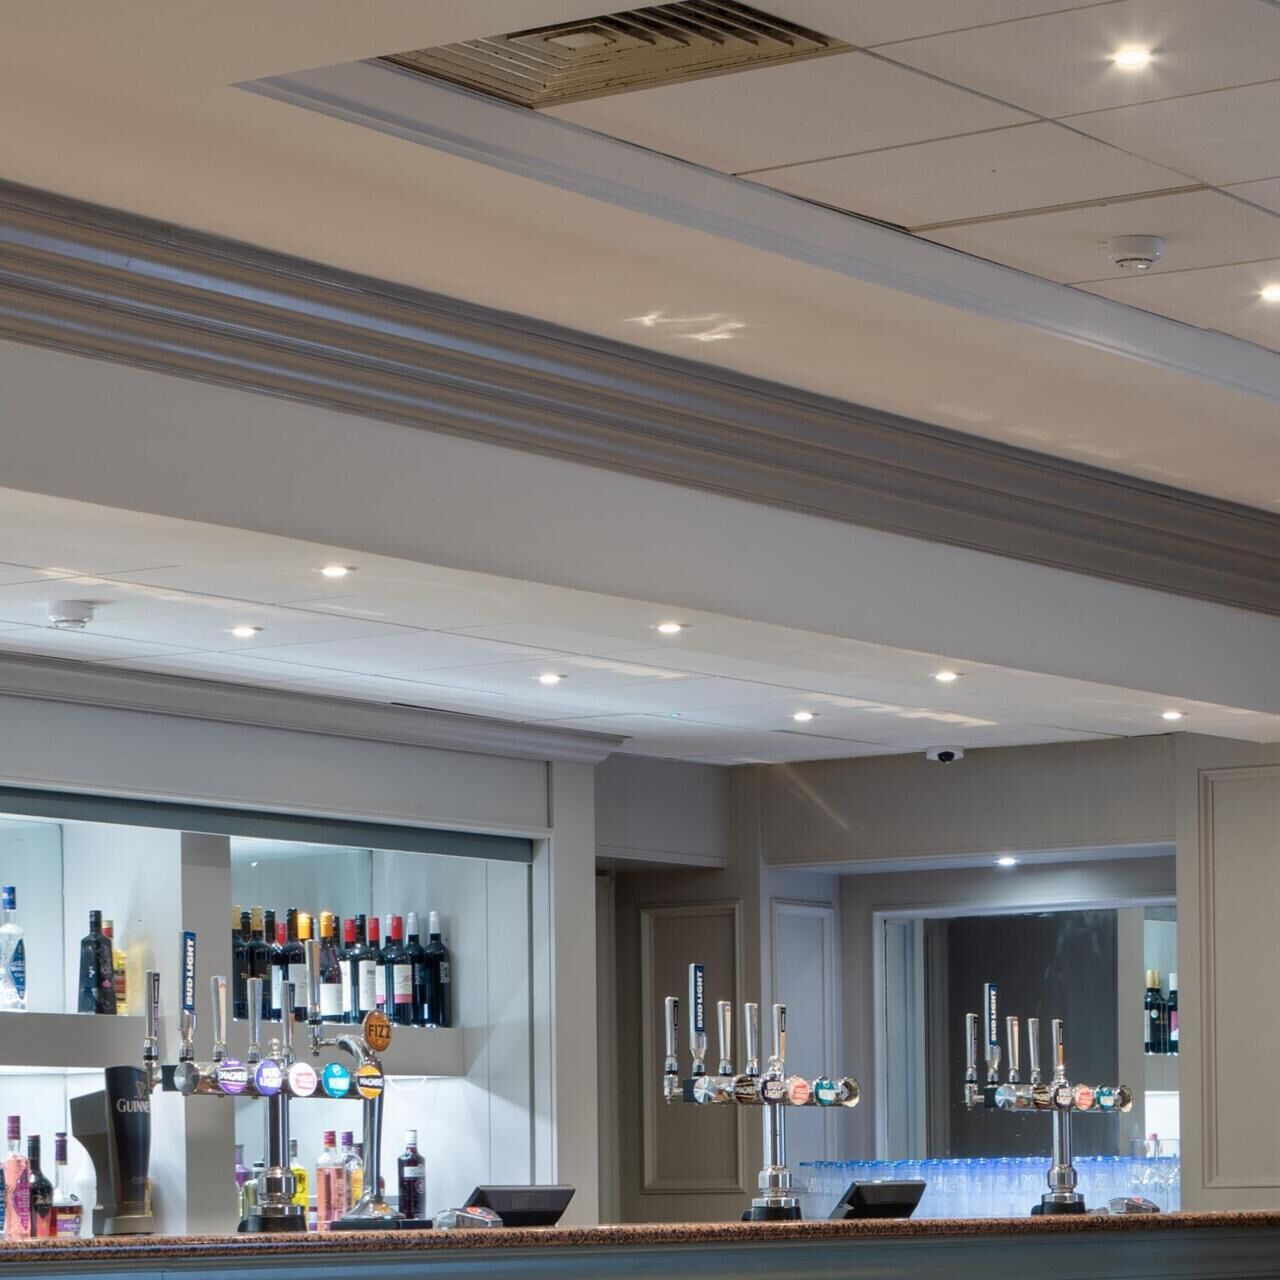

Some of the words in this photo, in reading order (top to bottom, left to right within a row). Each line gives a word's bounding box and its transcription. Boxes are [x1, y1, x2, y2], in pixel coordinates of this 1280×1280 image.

[186, 938, 195, 977] LIGHT
[186, 978, 194, 1006] BUD
[368, 1024, 391, 1039] FIZZ
[764, 1089, 784, 1099] LIGHT
